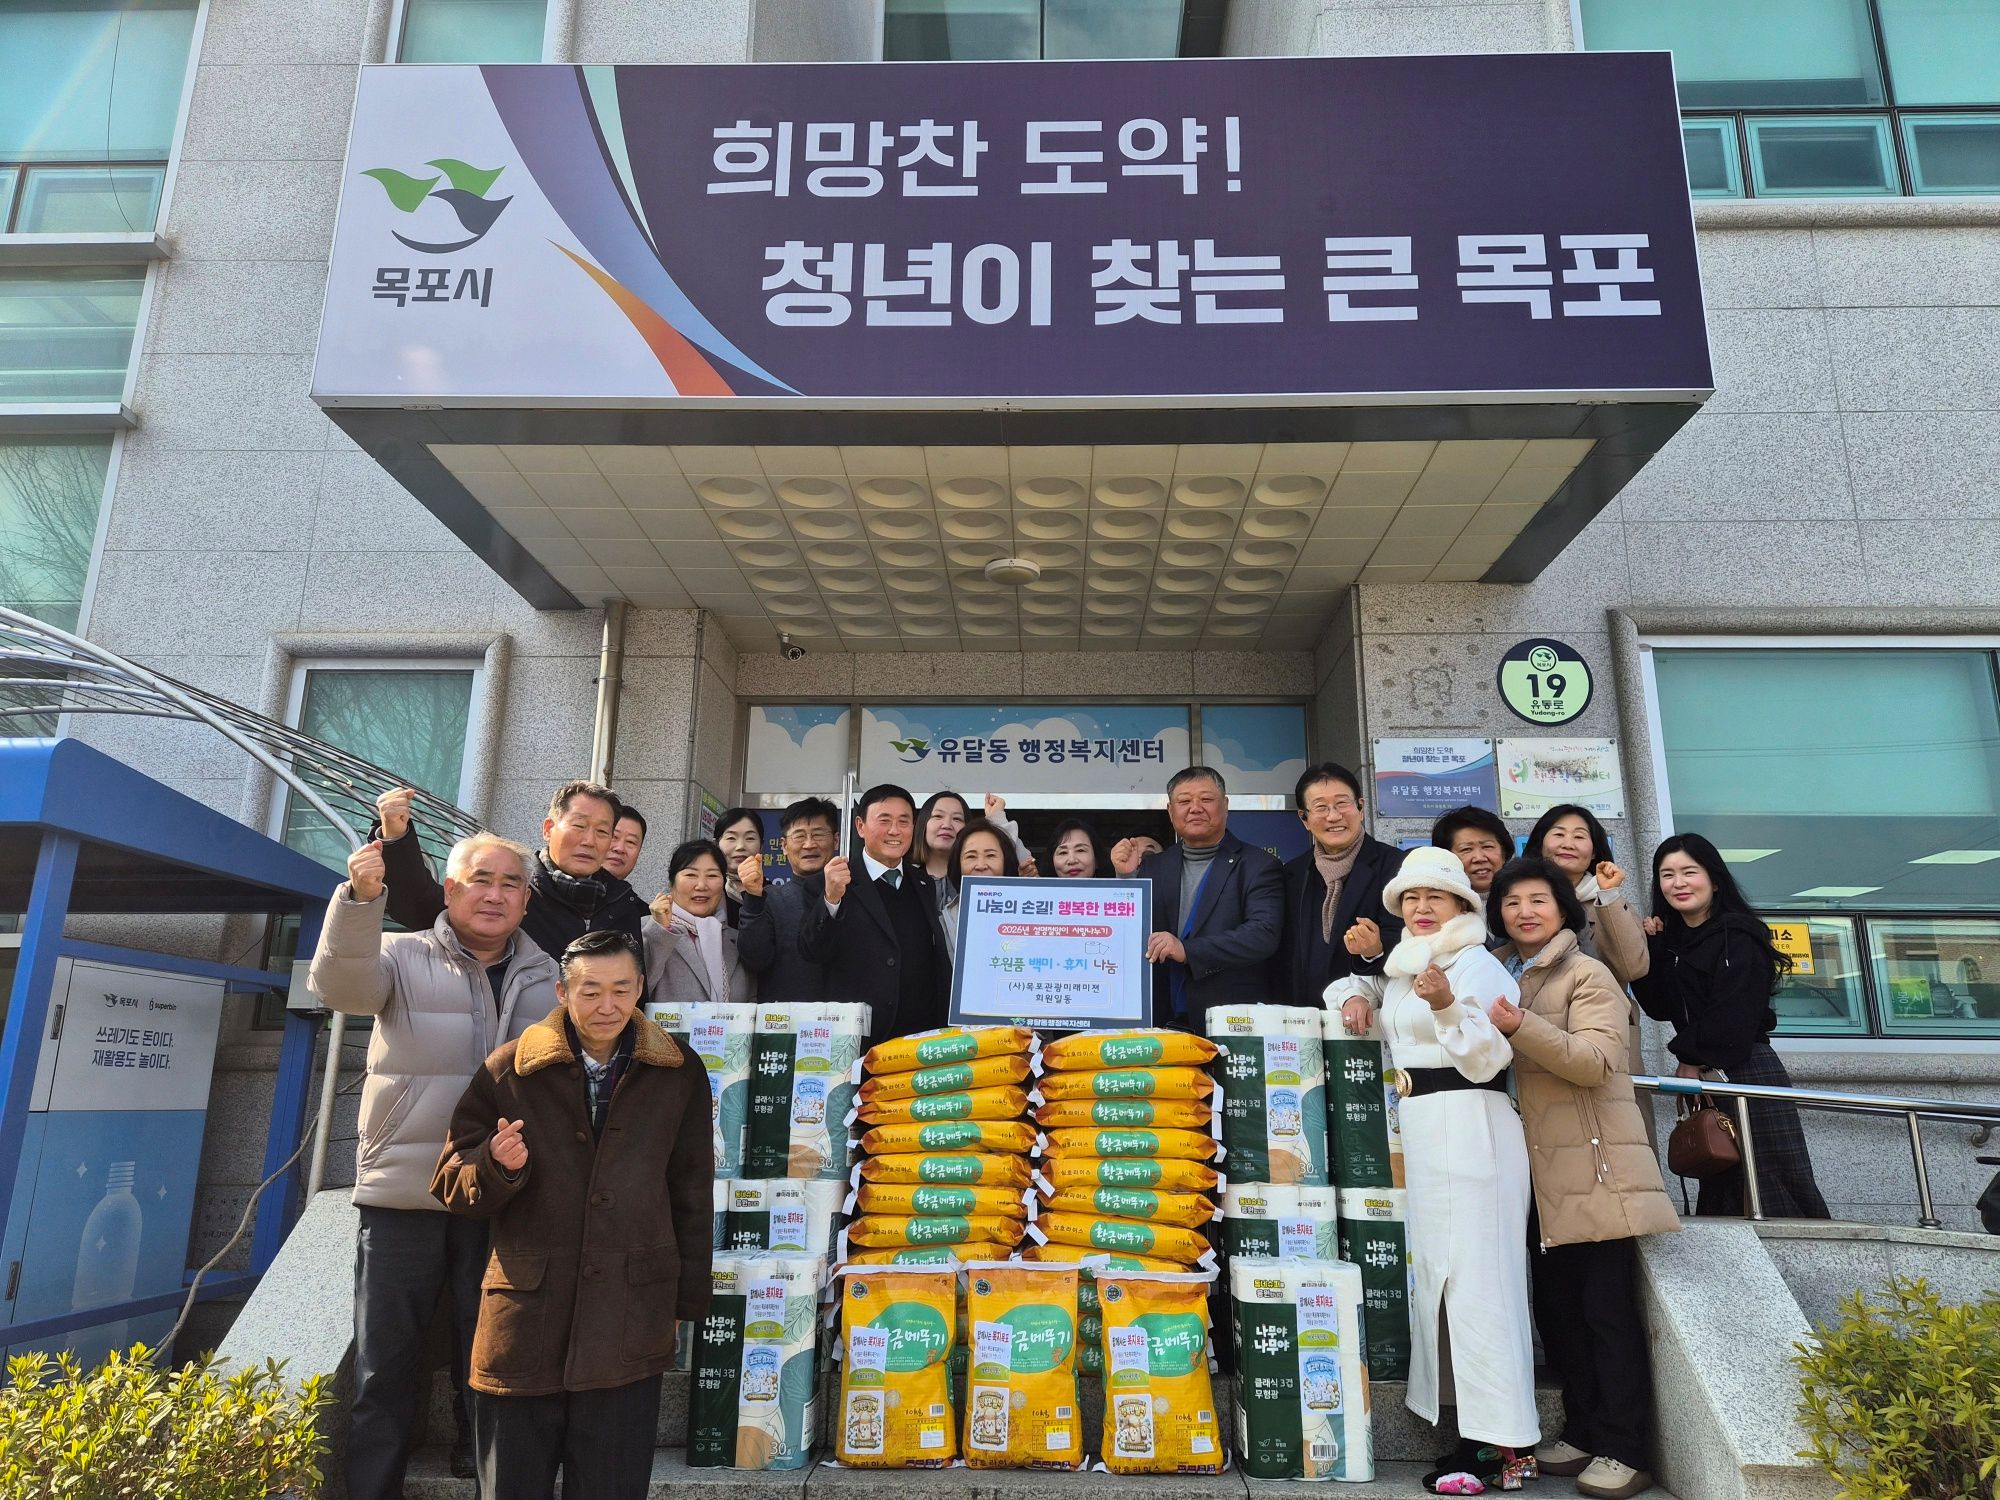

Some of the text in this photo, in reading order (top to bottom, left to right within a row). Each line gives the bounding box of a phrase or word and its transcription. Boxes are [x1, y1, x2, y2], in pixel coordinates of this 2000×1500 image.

[707, 117, 1242, 198] 희망찬 도약!
[372, 267, 493, 307] 목포시
[761, 232, 1663, 328] 청년이 찾는 큰 목포
[1526, 674, 1567, 698] 19
[1530, 699, 1565, 710] 유동로
[937, 738, 1164, 764] 유달동 행정복지센터
[1451, 755, 1466, 763] 목포
[1391, 785, 1481, 796] 유달동 행정복지센터
[977, 899, 1135, 916] 나눔의 손길! 행복한 변화!
[1002, 925, 1108, 937] 2026년 설명절맞이 사랑나누기
[989, 956, 1119, 974] 후원품 백미 휴지 나눔
[120, 997, 138, 1008] 목포시
[1035, 993, 1073, 1005] 회원일동
[96, 1026, 174, 1048] 쓰레기도 돈이다.
[92, 1049, 171, 1069] 재활용도 놀이다.
[761, 1050, 788, 1062] 나무야
[921, 1043, 969, 1060] 황금메뚜기
[1104, 1042, 1153, 1060] 황금메뚜기
[1228, 1053, 1256, 1065] 나무야
[758, 1062, 788, 1077] 나무야
[1345, 1058, 1373, 1070] 나무야
[1226, 1066, 1258, 1080] 나무야
[1344, 1070, 1376, 1084] 나무야
[915, 1073, 963, 1090] 황금메뚜기
[1096, 1076, 1145, 1093] 황금메뚜기
[755, 1095, 787, 1104] 클래식 3겹
[1226, 1099, 1260, 1108] 클래식 3겹
[1345, 1103, 1380, 1112] 클래식 3겹
[915, 1101, 962, 1116] 황금메뚜기
[1095, 1104, 1144, 1121] 황금메뚜기
[923, 1129, 971, 1145] 황금메뚜기
[1100, 1135, 1149, 1152] 황금메뚜기
[923, 1161, 972, 1178] 황금메뚜기
[1101, 1163, 1150, 1180] 황금메뚜기
[917, 1192, 966, 1209] 황금메뚜기
[1099, 1190, 1148, 1207] 황금메뚜기
[733, 1230, 761, 1243] 나무야
[910, 1223, 959, 1240] 황금메뚜기
[1095, 1224, 1144, 1242] 황금메뚜기
[1240, 1238, 1270, 1251] 나무야
[1367, 1239, 1397, 1253] 나무야
[1365, 1253, 1399, 1269] 나무야
[1365, 1289, 1402, 1299] 클래식 3겹
[705, 1315, 736, 1329] 나무야
[703, 1329, 737, 1346] 나무야
[882, 1326, 945, 1350] 금메뚜기
[1255, 1323, 1288, 1339] 나무야
[1010, 1327, 1070, 1352] 금메뚜기
[1148, 1331, 1204, 1356] 금메뚜기
[1254, 1338, 1290, 1356] 나무야
[699, 1368, 736, 1378] 클래식 3겹
[1254, 1378, 1294, 1389] 클래식 3겹
